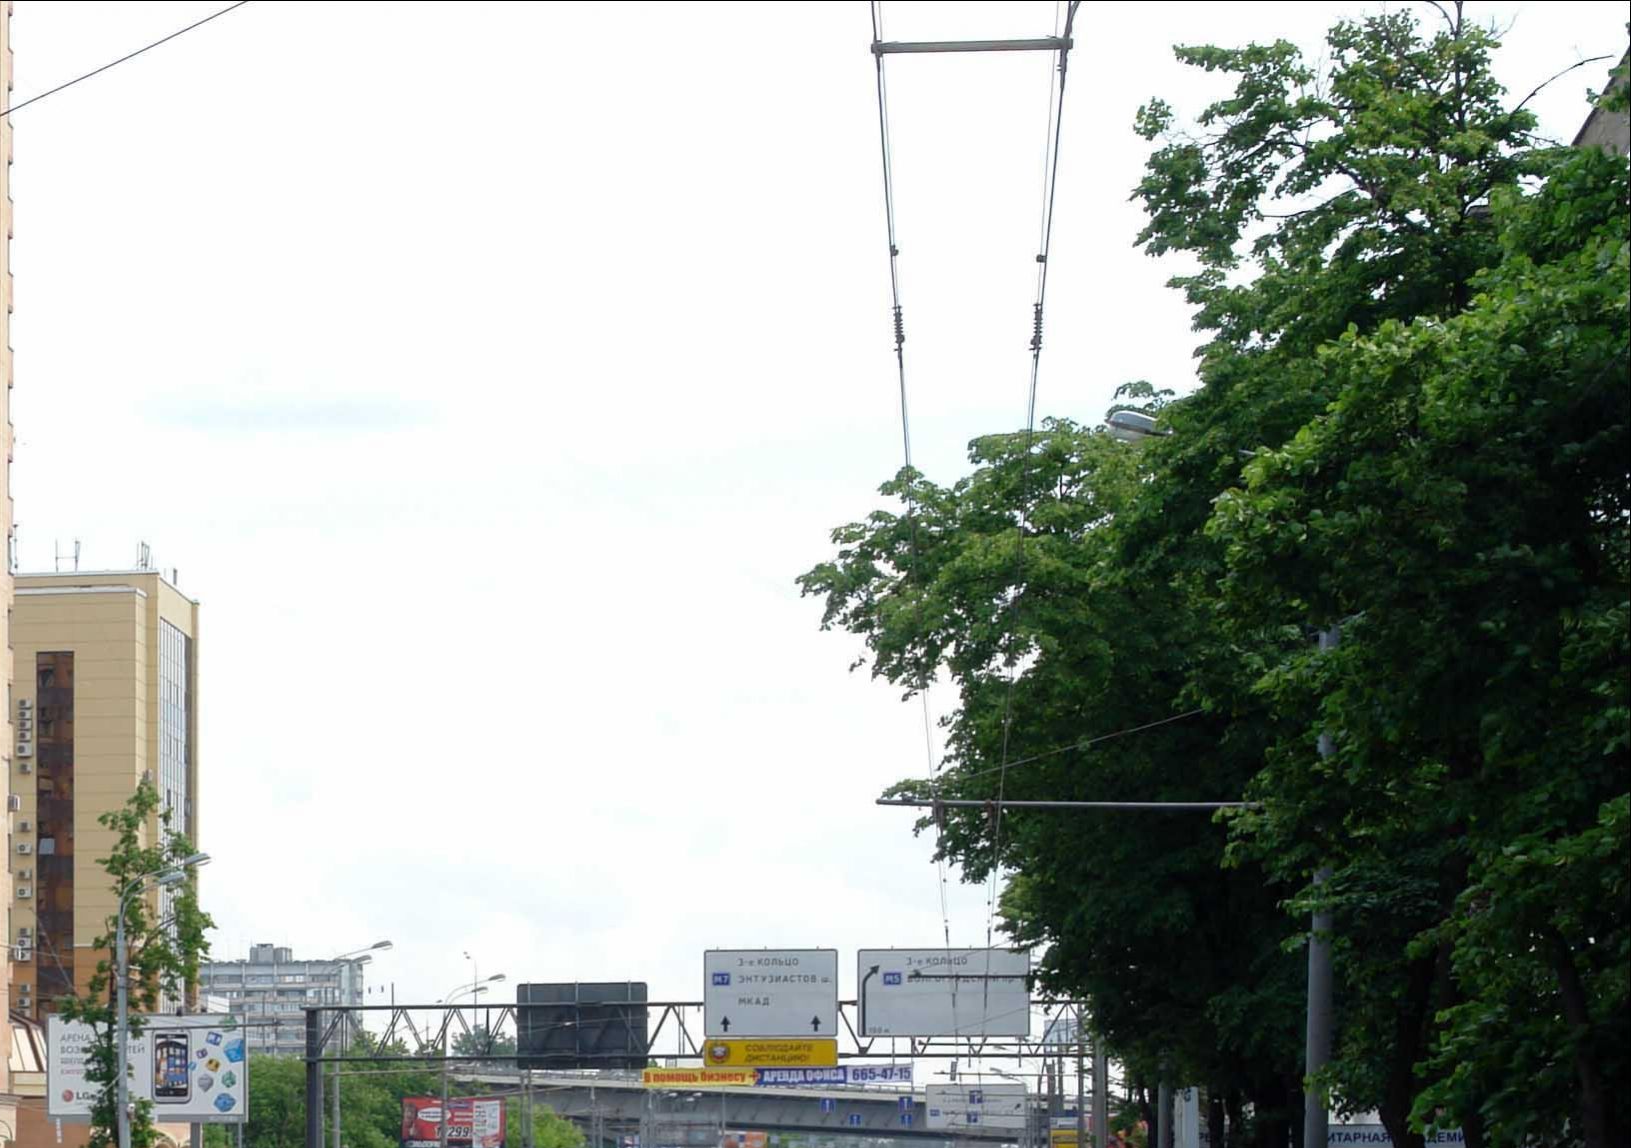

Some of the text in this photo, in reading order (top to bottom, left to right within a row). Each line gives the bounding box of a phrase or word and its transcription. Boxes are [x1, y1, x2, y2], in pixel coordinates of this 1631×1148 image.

[757, 958, 799, 968] КОЛЬЦО
[737, 974, 817, 984] ЭНТУЗИАСТОВ
[737, 997, 771, 1007] МКАД
[653, 1071, 699, 1084] помощь
[700, 1070, 746, 1083] бизнесу
[762, 1068, 806, 1082] АРЕНДА
[806, 1067, 844, 1081] ОФИСА
[852, 1066, 911, 1081] 665-47-15
